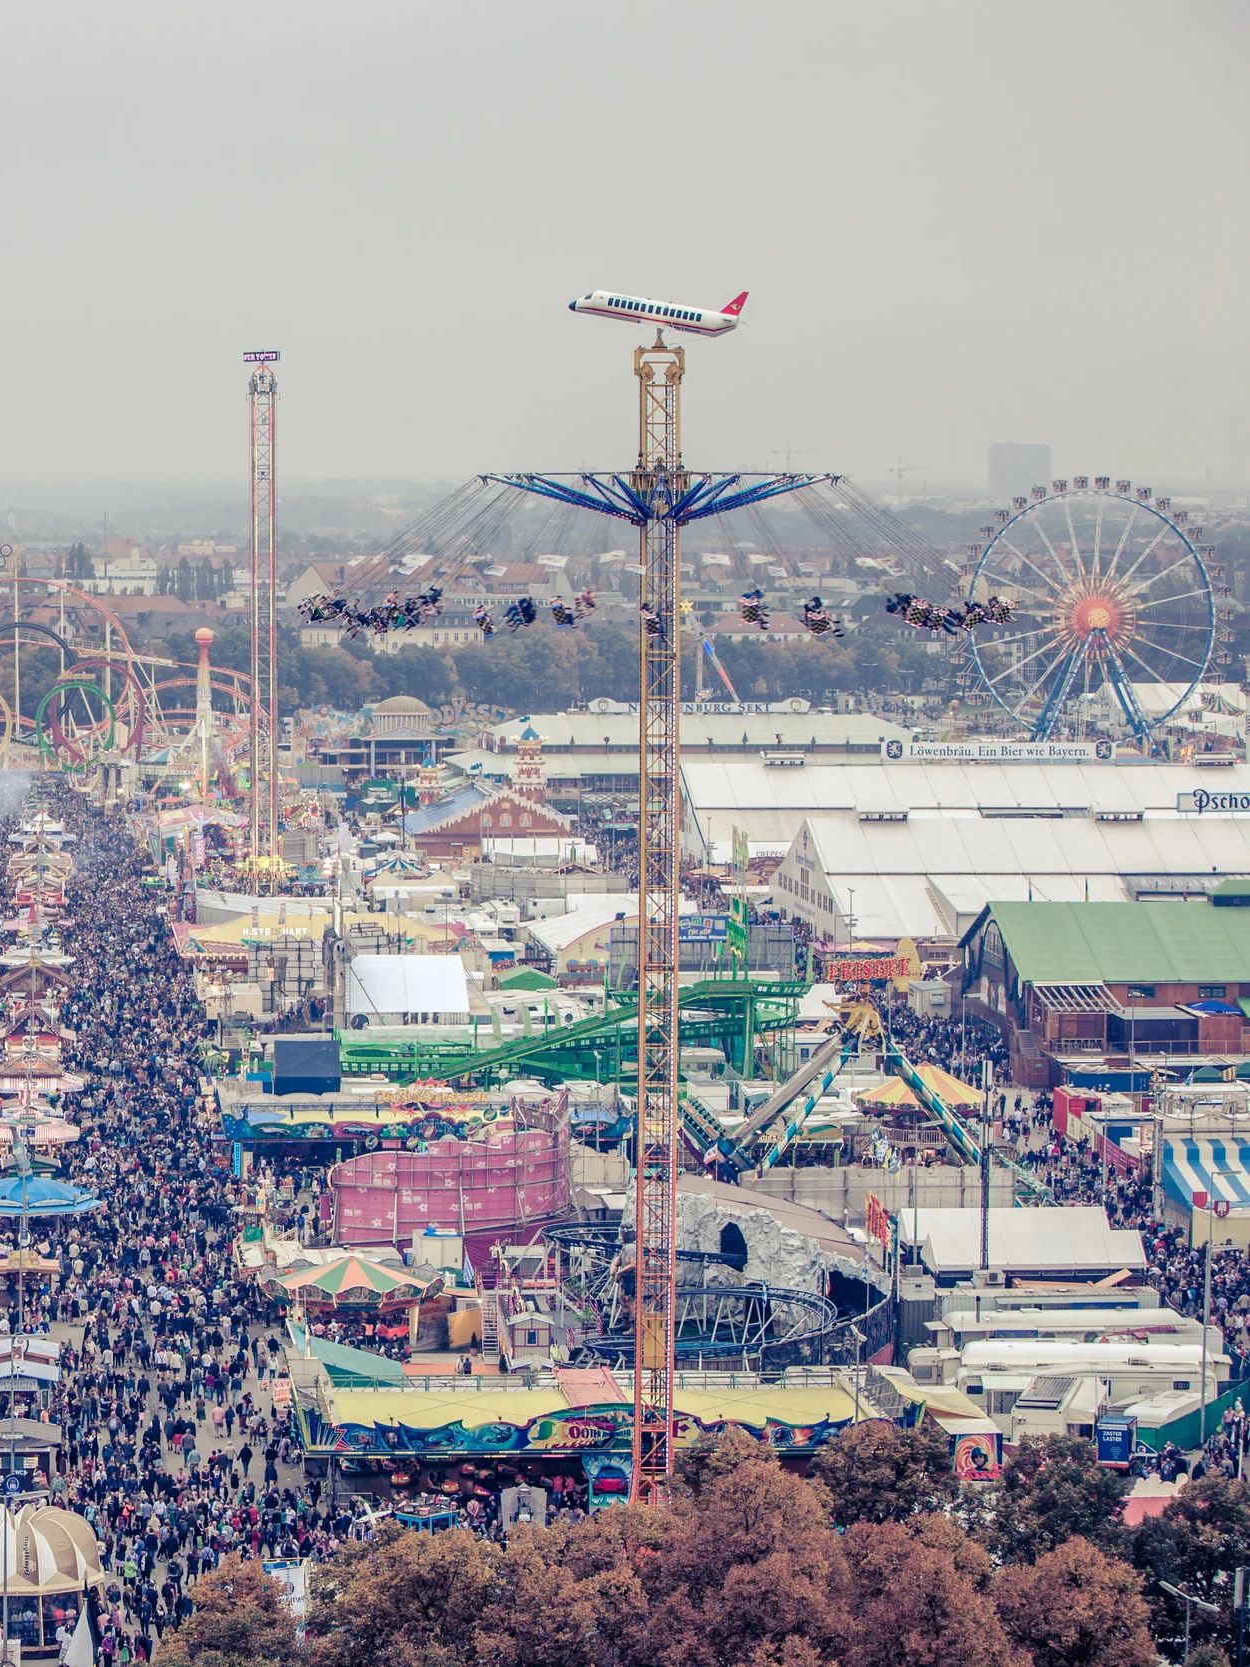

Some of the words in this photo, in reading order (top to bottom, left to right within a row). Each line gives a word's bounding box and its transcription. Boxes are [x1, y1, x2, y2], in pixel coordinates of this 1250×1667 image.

[910, 745, 974, 756] Löwenbräu.
[978, 746, 996, 756] Ein
[1001, 746, 1023, 756] Bier
[1026, 746, 1044, 756] wie
[1048, 746, 1089, 758] Bayern.
[828, 957, 911, 981] FRISBEE
